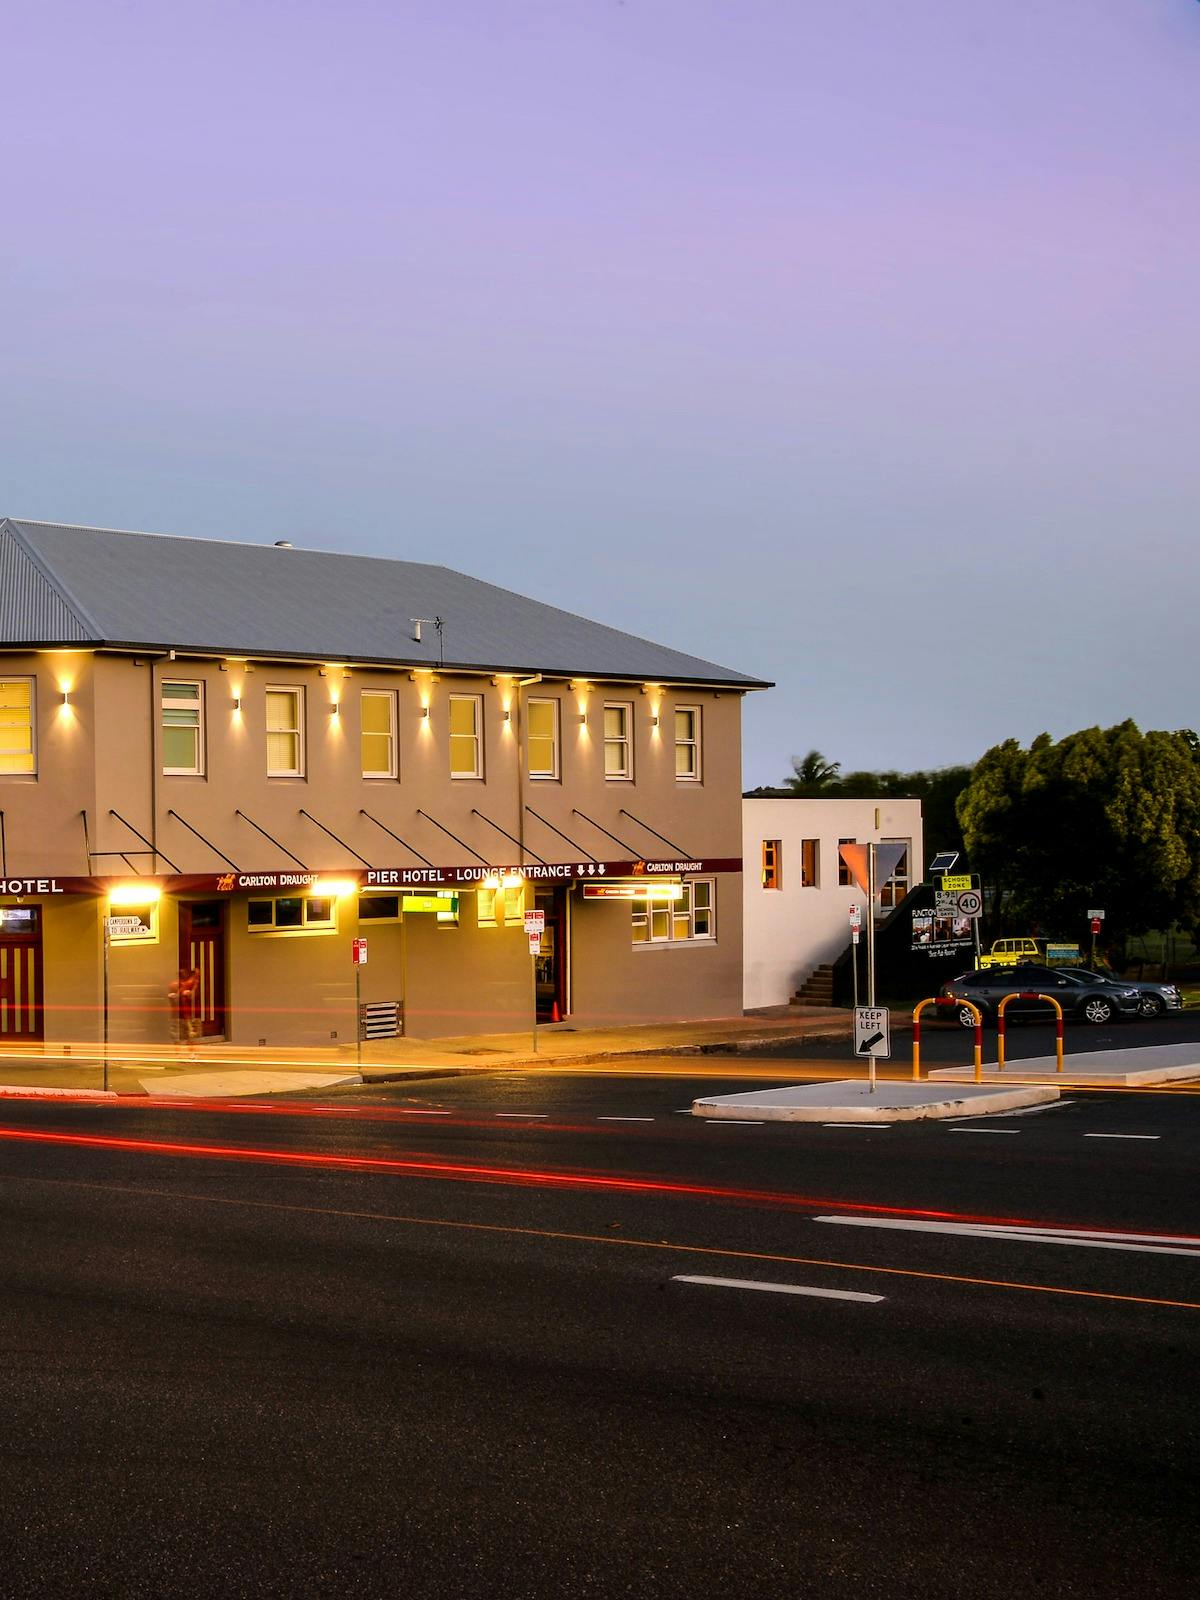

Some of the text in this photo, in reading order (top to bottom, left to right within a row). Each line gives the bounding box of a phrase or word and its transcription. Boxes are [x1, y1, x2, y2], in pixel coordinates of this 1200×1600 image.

[646, 862, 702, 872] CARLTON DRAUGHT
[367, 870, 398, 883] PIER
[402, 869, 445, 882] HOTEL
[456, 867, 506, 880] LOUNGE
[510, 865, 572, 878] ENTRANCE
[238, 874, 320, 887] CARLTON DRAUGHT
[961, 898, 977, 908] 40
[860, 1011, 882, 1020] KEEP
[860, 1021, 881, 1030] LEFT
